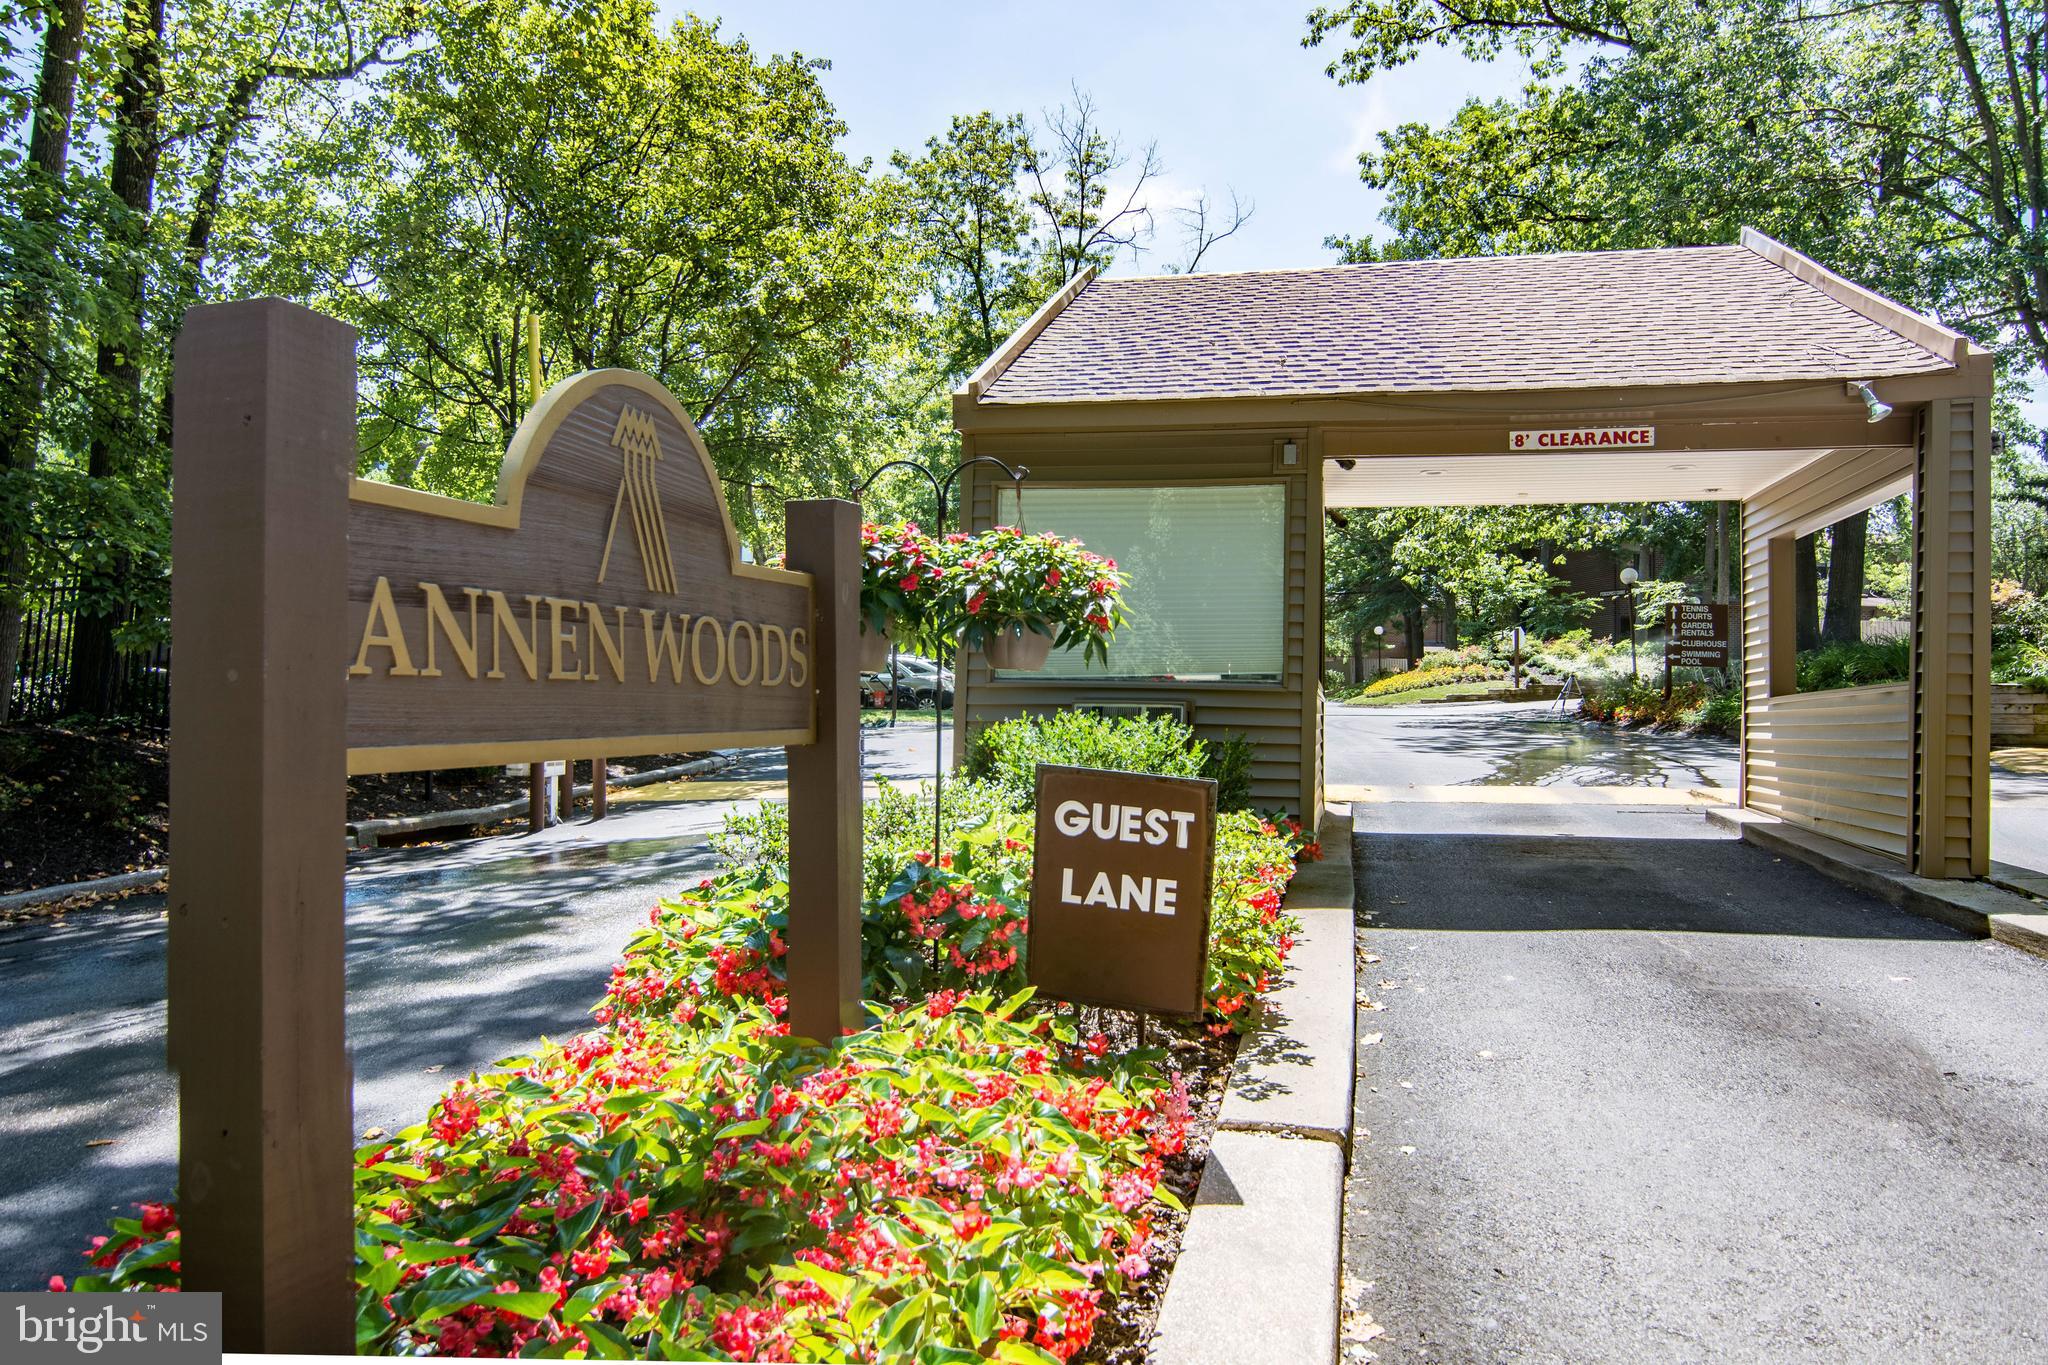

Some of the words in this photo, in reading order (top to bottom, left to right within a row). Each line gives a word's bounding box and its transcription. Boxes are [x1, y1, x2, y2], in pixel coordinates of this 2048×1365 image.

[1538, 430, 1650, 447] CLEARANCE
[1681, 612, 1712, 620] COURTS
[1681, 621, 1712, 629] GARDEN
[349, 576, 629, 683] ANNEN
[639, 608, 808, 687] WOODS
[1681, 629, 1714, 637] RENTALS
[1681, 640, 1727, 648] CLUBHOUSE
[1681, 650, 1720, 658] SWIMMING
[1054, 800, 1195, 849] GUEST
[1061, 868, 1177, 915] LANE
